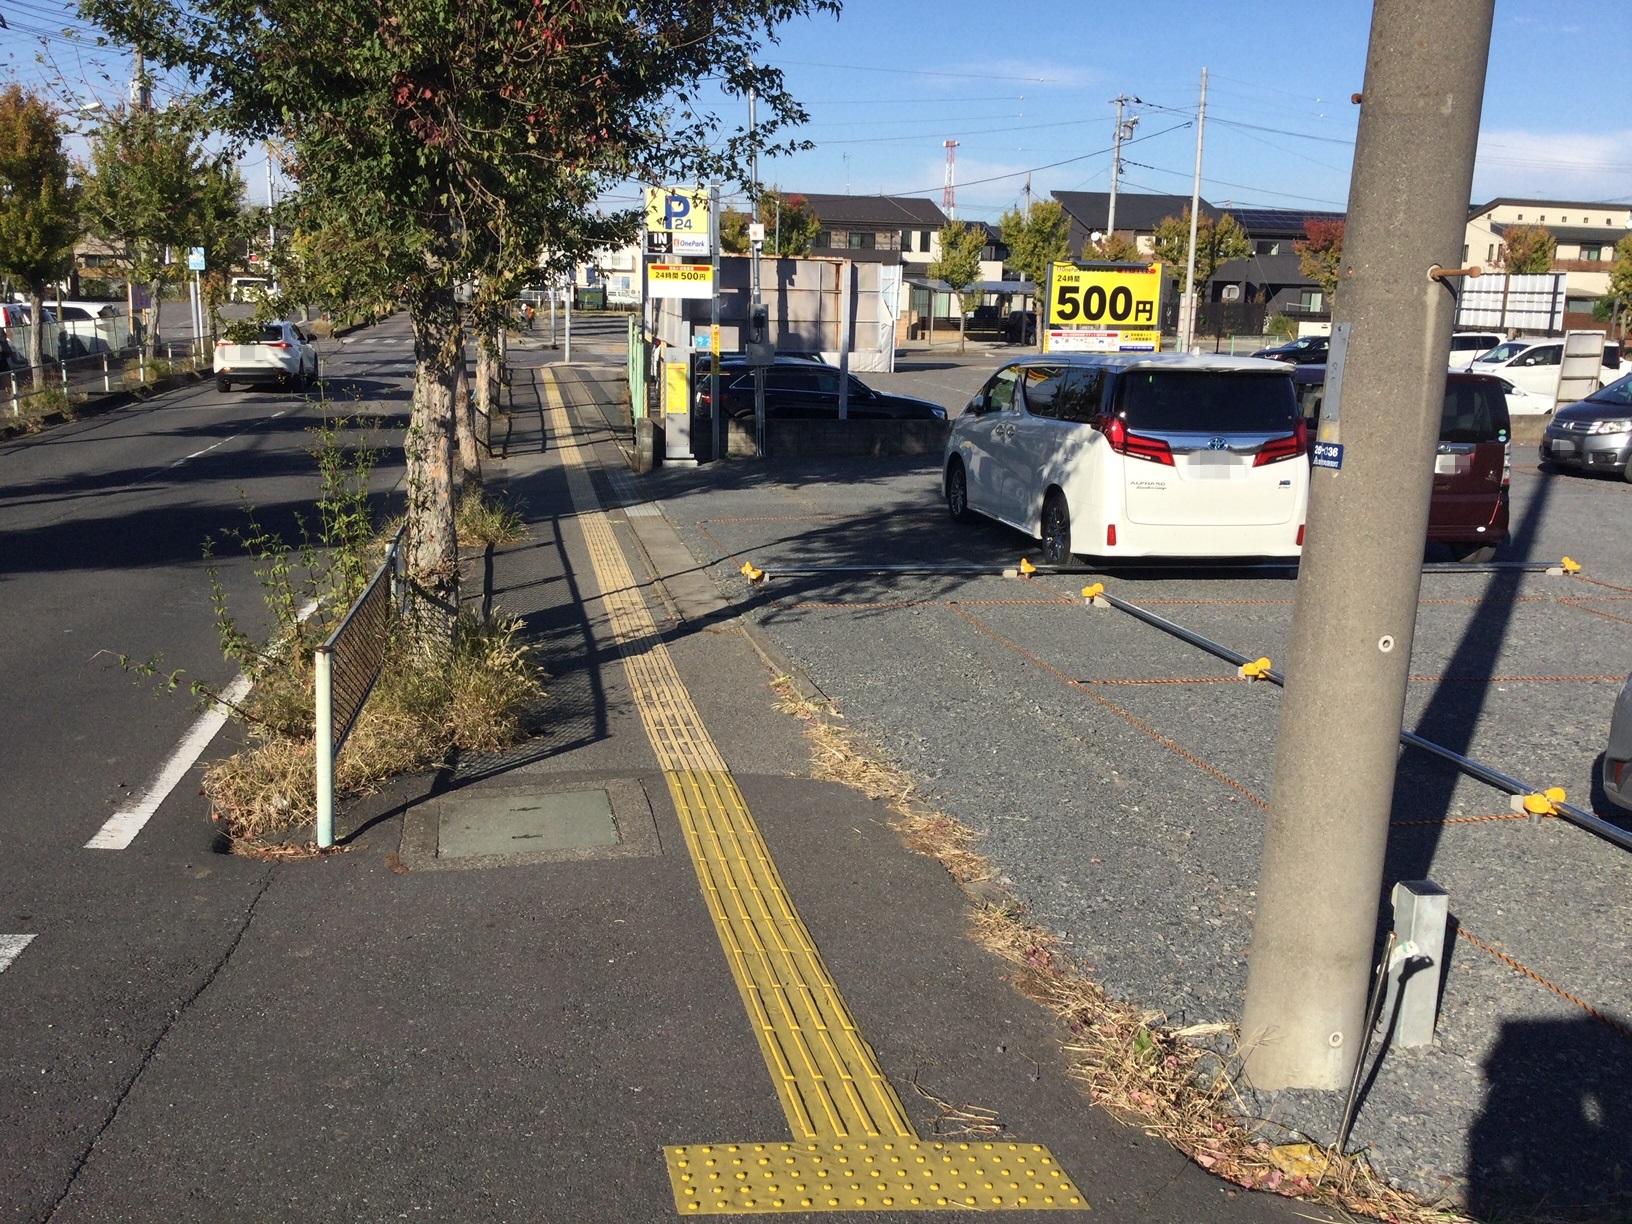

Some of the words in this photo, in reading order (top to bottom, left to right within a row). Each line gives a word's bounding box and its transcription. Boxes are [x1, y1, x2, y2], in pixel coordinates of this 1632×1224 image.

[665, 196, 690, 229] P
[675, 219, 692, 230] 24
[654, 233, 667, 244] IN
[680, 239, 704, 247] OnePark
[655, 271, 679, 279] 24時間
[680, 272, 706, 281] 500円
[1057, 274, 1080, 282] 24時間
[1056, 285, 1154, 322] 500円
